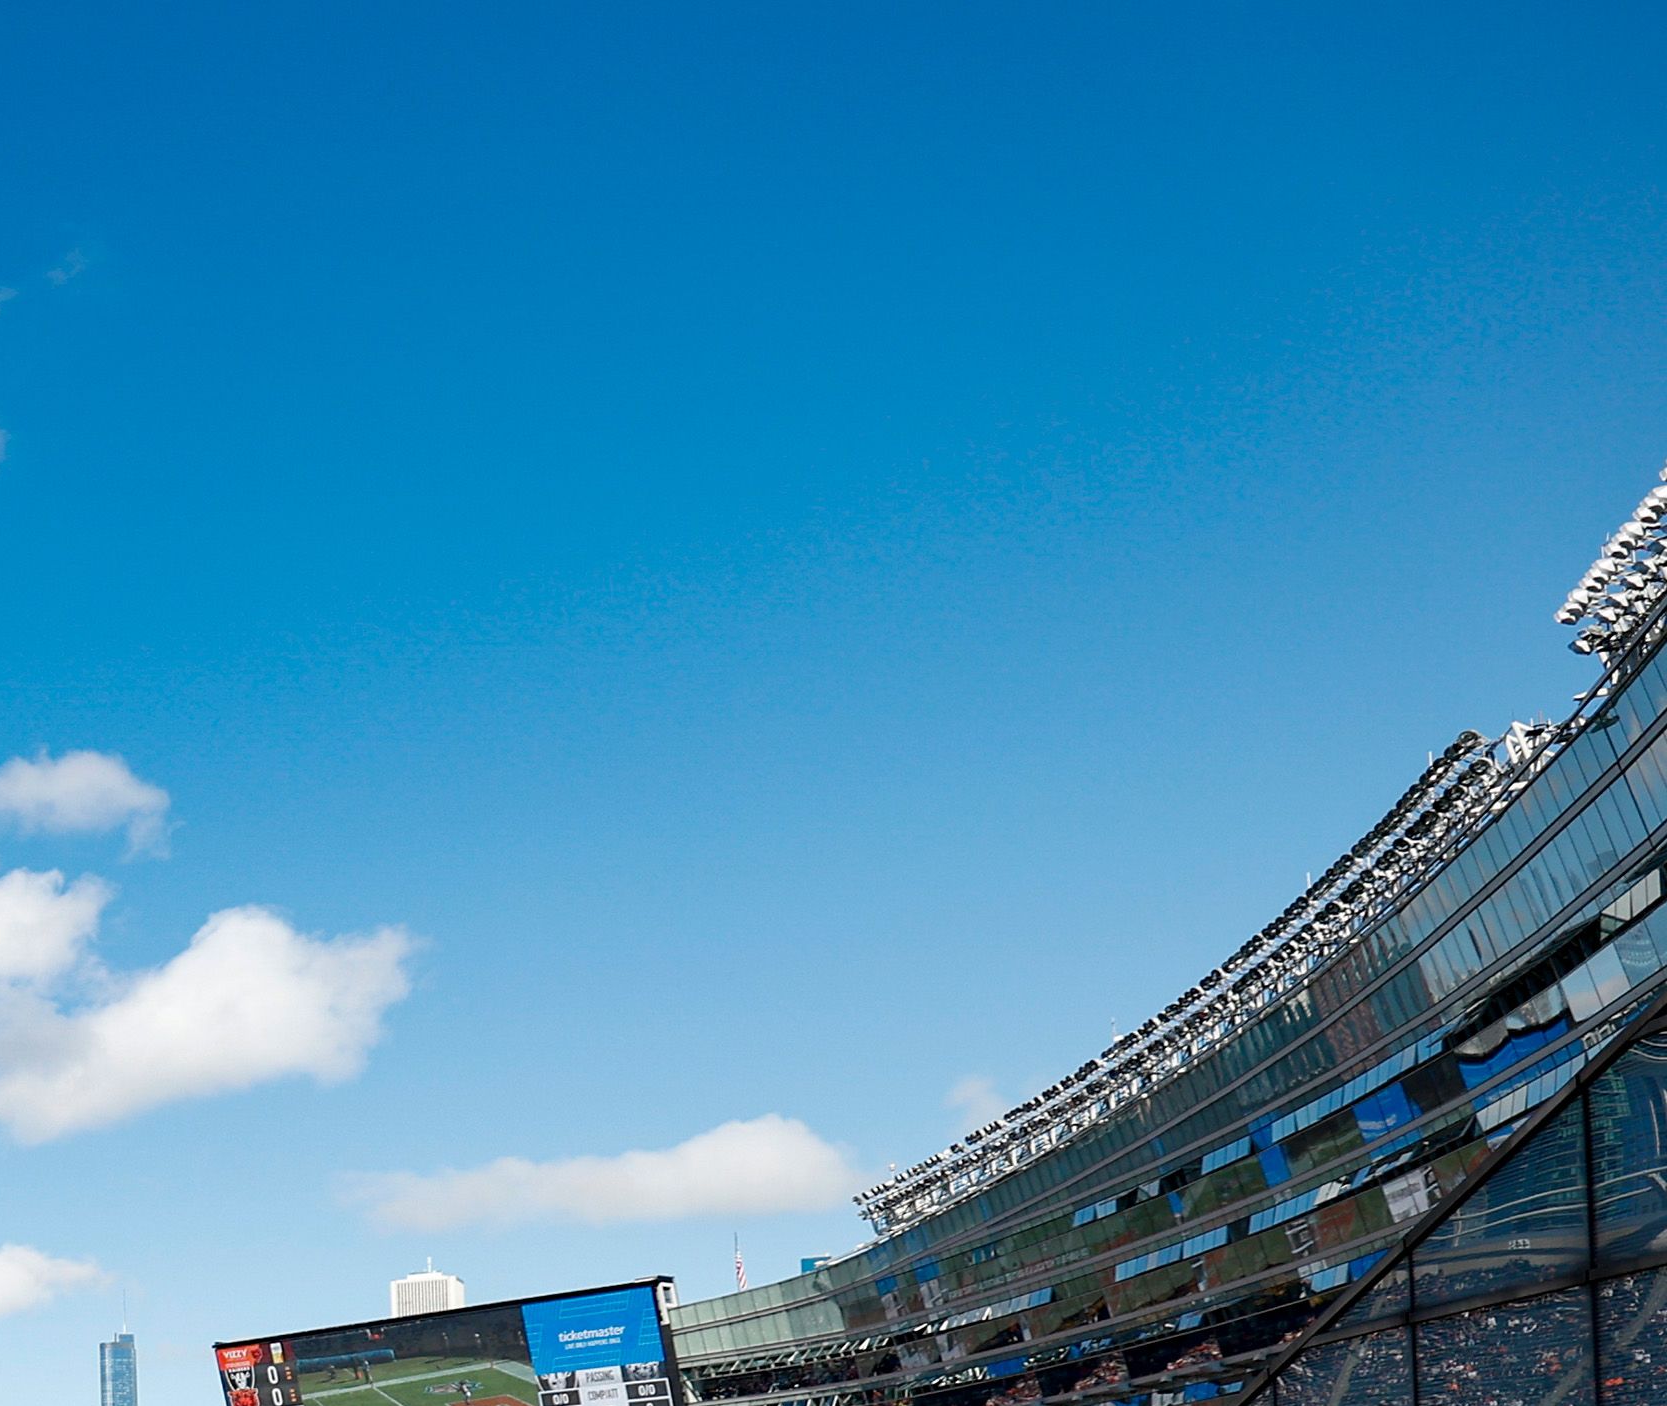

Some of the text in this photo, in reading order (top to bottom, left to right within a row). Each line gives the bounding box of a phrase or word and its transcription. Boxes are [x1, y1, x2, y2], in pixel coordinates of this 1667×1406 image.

[558, 1326, 625, 1343] ticketmaster
[223, 1349, 248, 1359] VIZZY
[267, 1365, 279, 1385] 0
[586, 1370, 614, 1383] PASSING
[272, 1388, 284, 1406] 0
[552, 1393, 569, 1405] 0/0
[638, 1384, 656, 1396] 0/0
